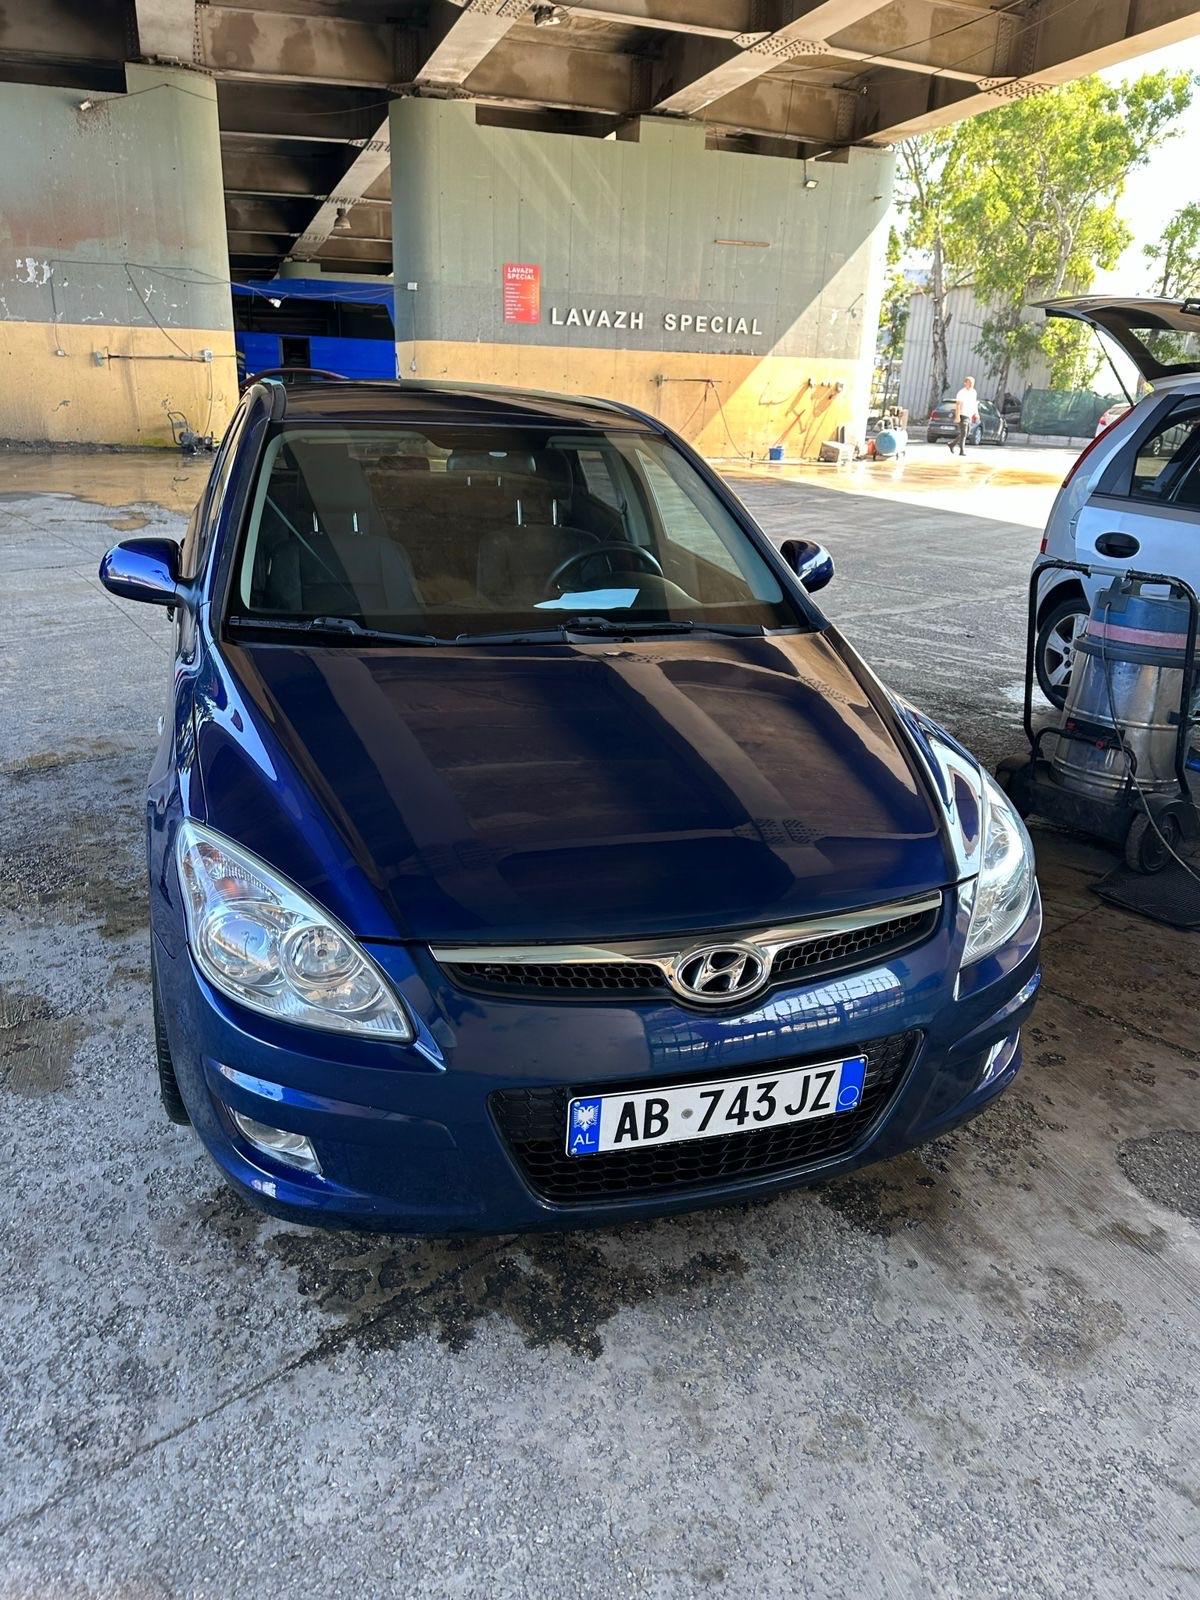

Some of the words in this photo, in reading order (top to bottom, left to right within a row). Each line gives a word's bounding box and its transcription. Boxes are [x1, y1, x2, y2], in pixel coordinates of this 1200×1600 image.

[507, 266, 534, 274] LAVAZH
[551, 307, 644, 330] LAVAZH
[664, 313, 763, 335] SPECIAL
[613, 1098, 669, 1143] AB
[697, 1080, 779, 1132] 743
[784, 1070, 837, 1116] JZ
[573, 1133, 596, 1146] AL
